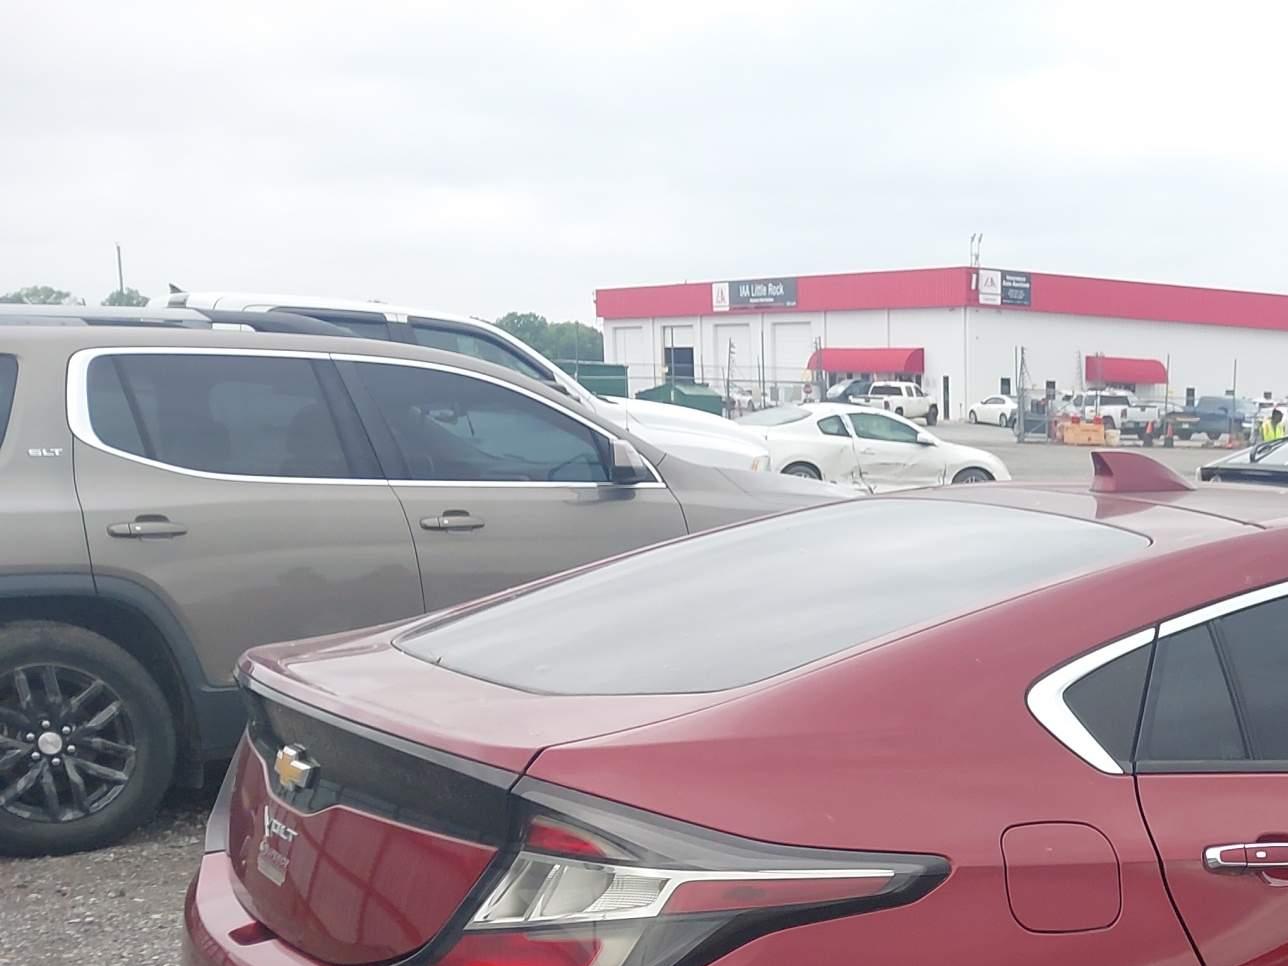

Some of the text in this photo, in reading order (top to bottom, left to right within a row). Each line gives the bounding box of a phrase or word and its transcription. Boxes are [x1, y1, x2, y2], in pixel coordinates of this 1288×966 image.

[739, 284, 750, 297] IAA
[750, 283, 767, 297] Little
[768, 281, 784, 296] Rock
[28, 448, 63, 457] SLT
[264, 805, 298, 842] VOLT
